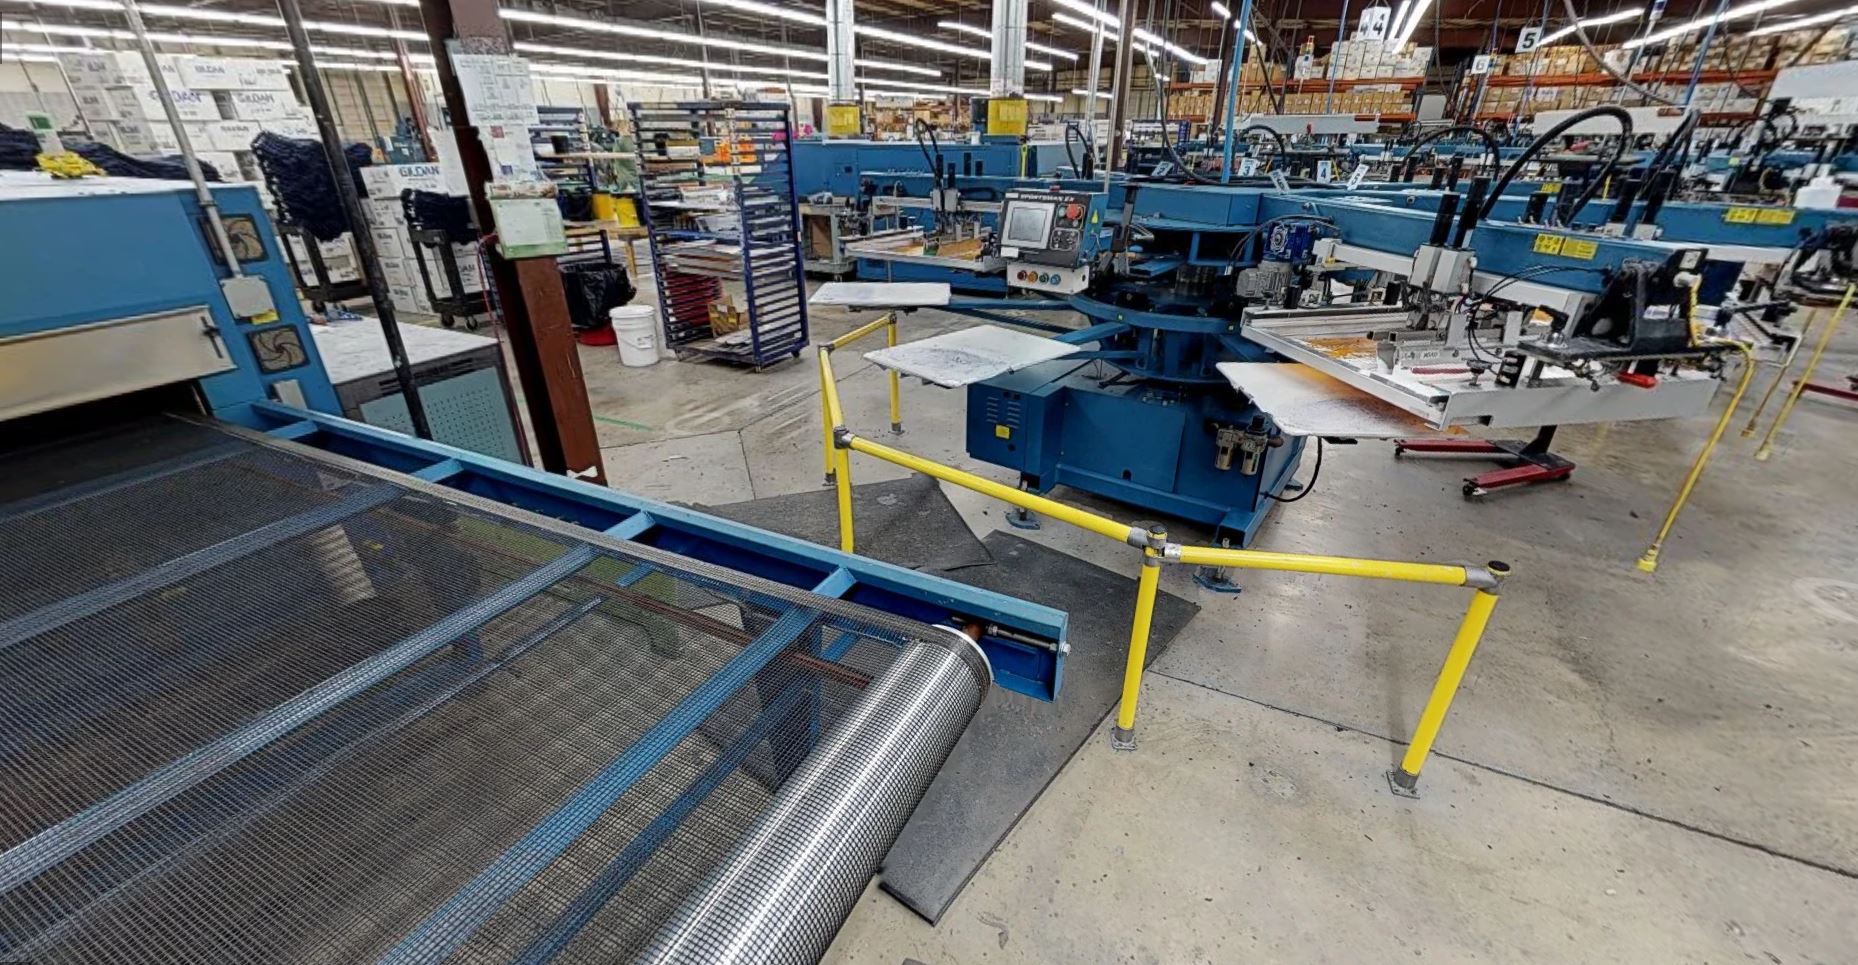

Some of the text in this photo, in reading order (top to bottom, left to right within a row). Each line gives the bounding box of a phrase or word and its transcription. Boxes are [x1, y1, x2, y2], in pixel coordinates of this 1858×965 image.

[1373, 22, 1383, 36] 4
[1522, 32, 1537, 49] 5
[149, 90, 203, 103] GDAN
[399, 164, 440, 178] GILDAN
[1243, 165, 1251, 177] 3
[1320, 167, 1328, 179] 4
